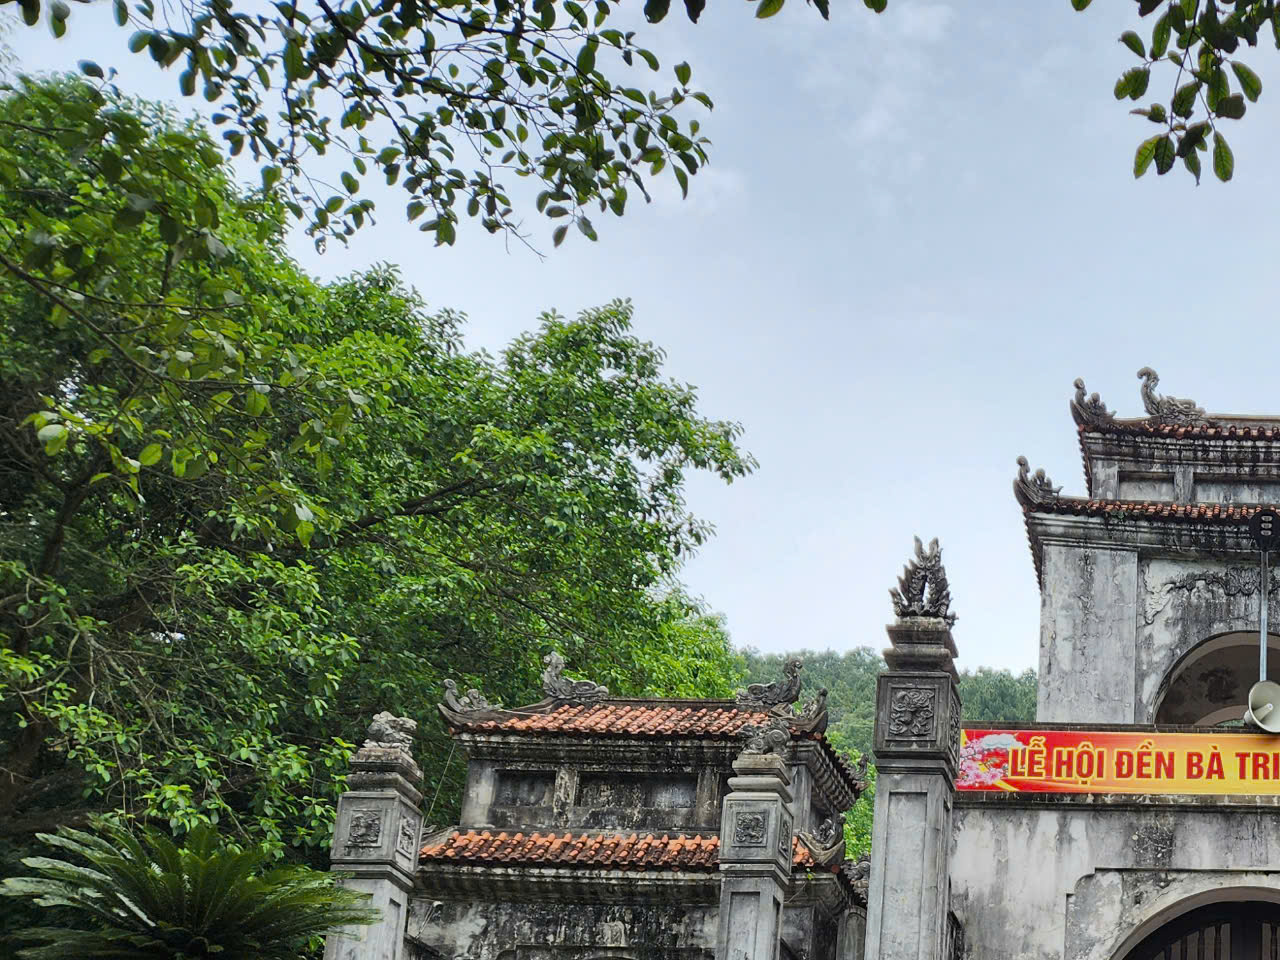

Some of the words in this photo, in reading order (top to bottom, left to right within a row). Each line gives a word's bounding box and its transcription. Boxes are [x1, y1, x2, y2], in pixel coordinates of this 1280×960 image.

[1009, 736, 1045, 778] LỄ
[1055, 743, 1104, 785] HỘI
[1114, 741, 1175, 780] ĐỀN
[1186, 744, 1225, 781] BÀ
